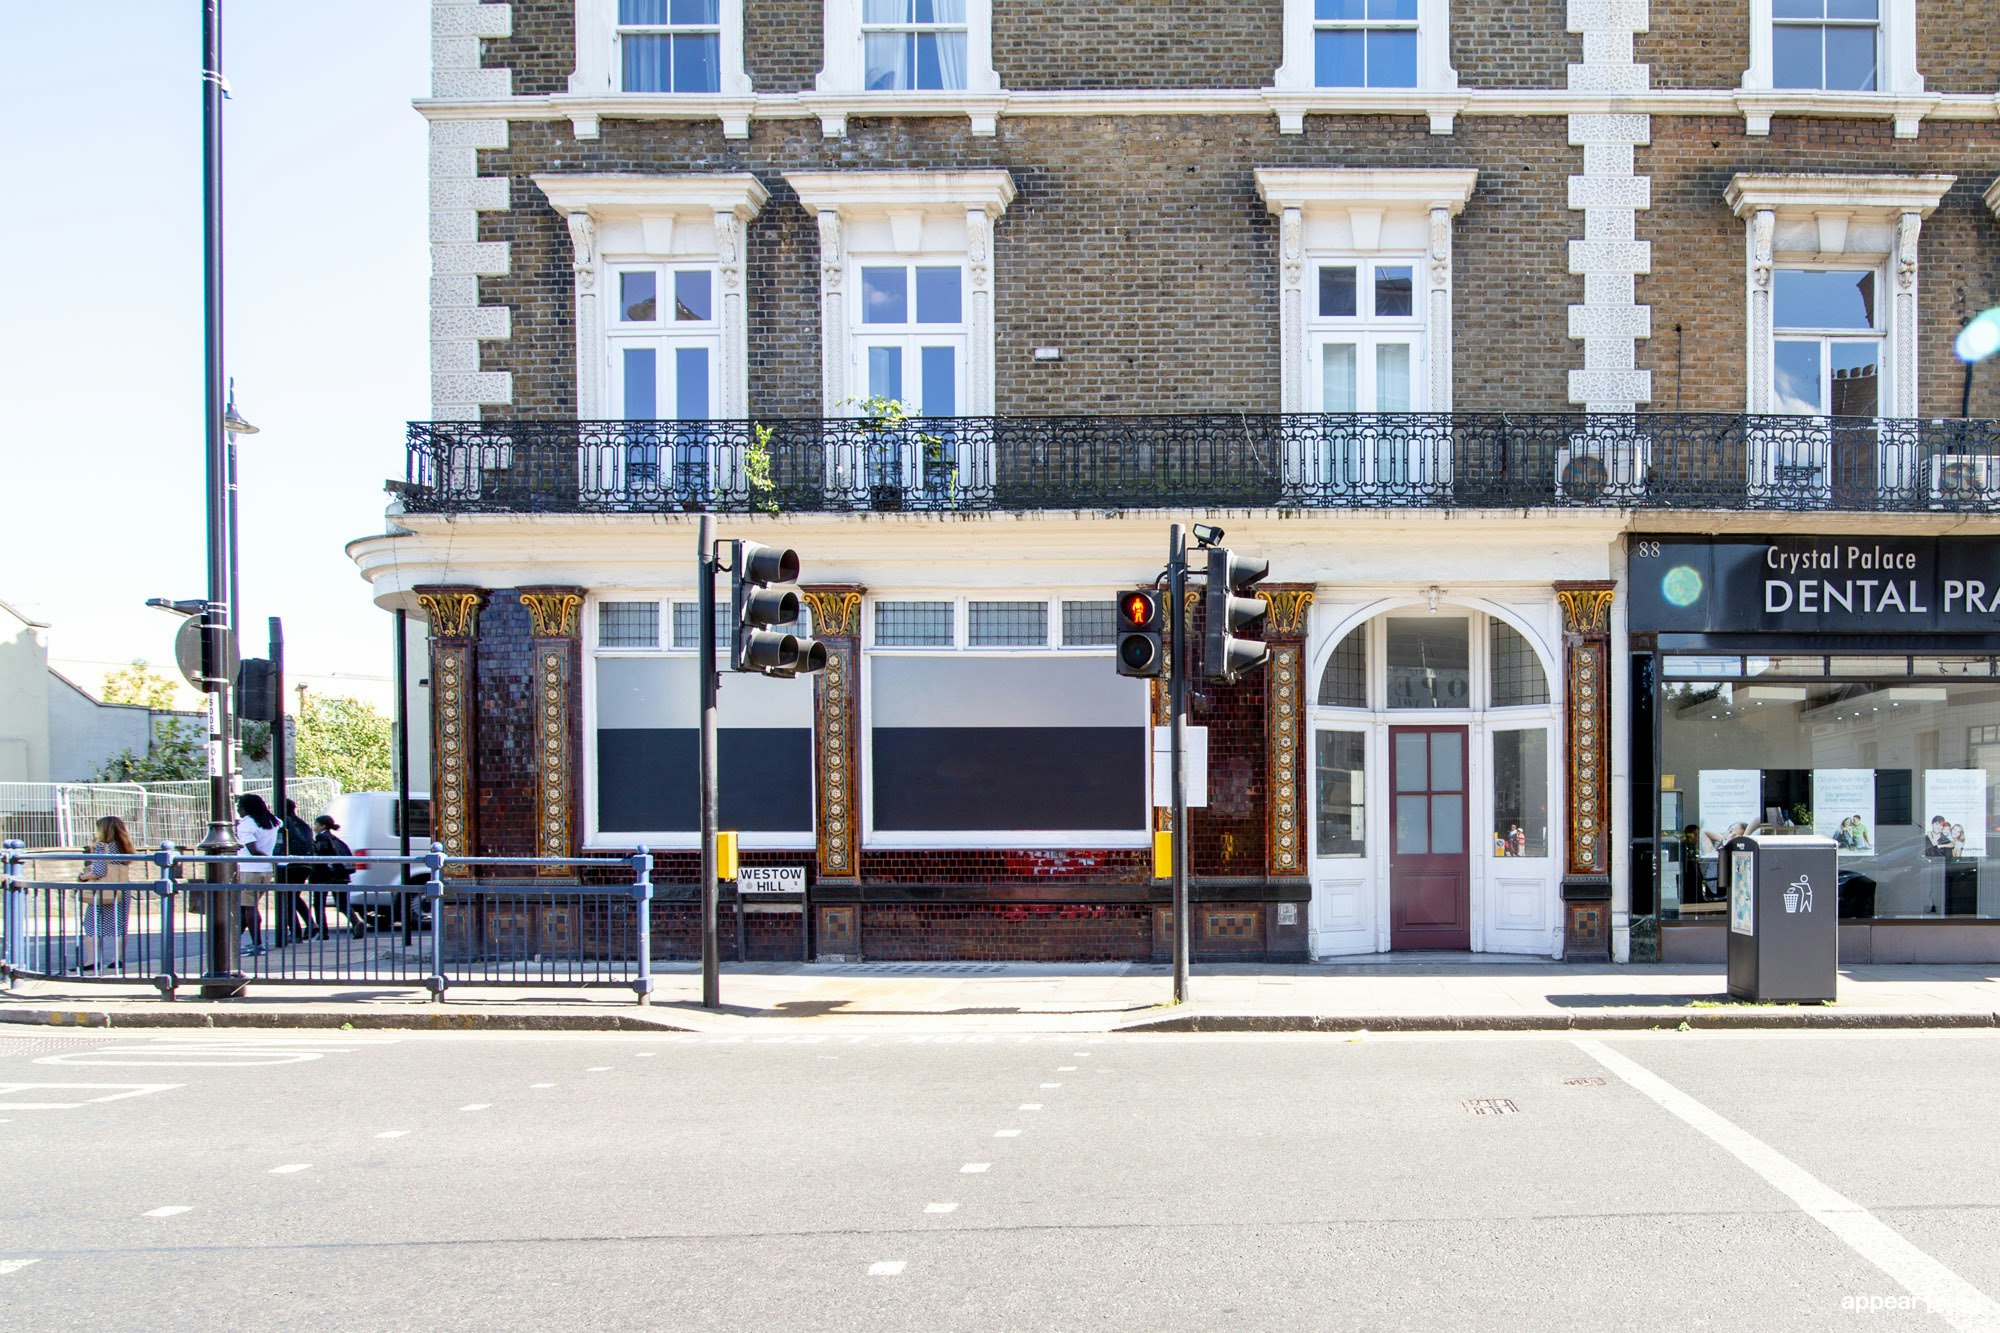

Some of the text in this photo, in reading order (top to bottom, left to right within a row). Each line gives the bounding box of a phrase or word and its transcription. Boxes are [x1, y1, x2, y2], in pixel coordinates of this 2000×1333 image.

[1639, 541, 1660, 558] 88
[1767, 545, 1916, 574] Crystal Palace
[1765, 580, 1927, 613] DENTAL
[740, 868, 802, 880] WESTOW
[757, 881, 785, 892] HILL
